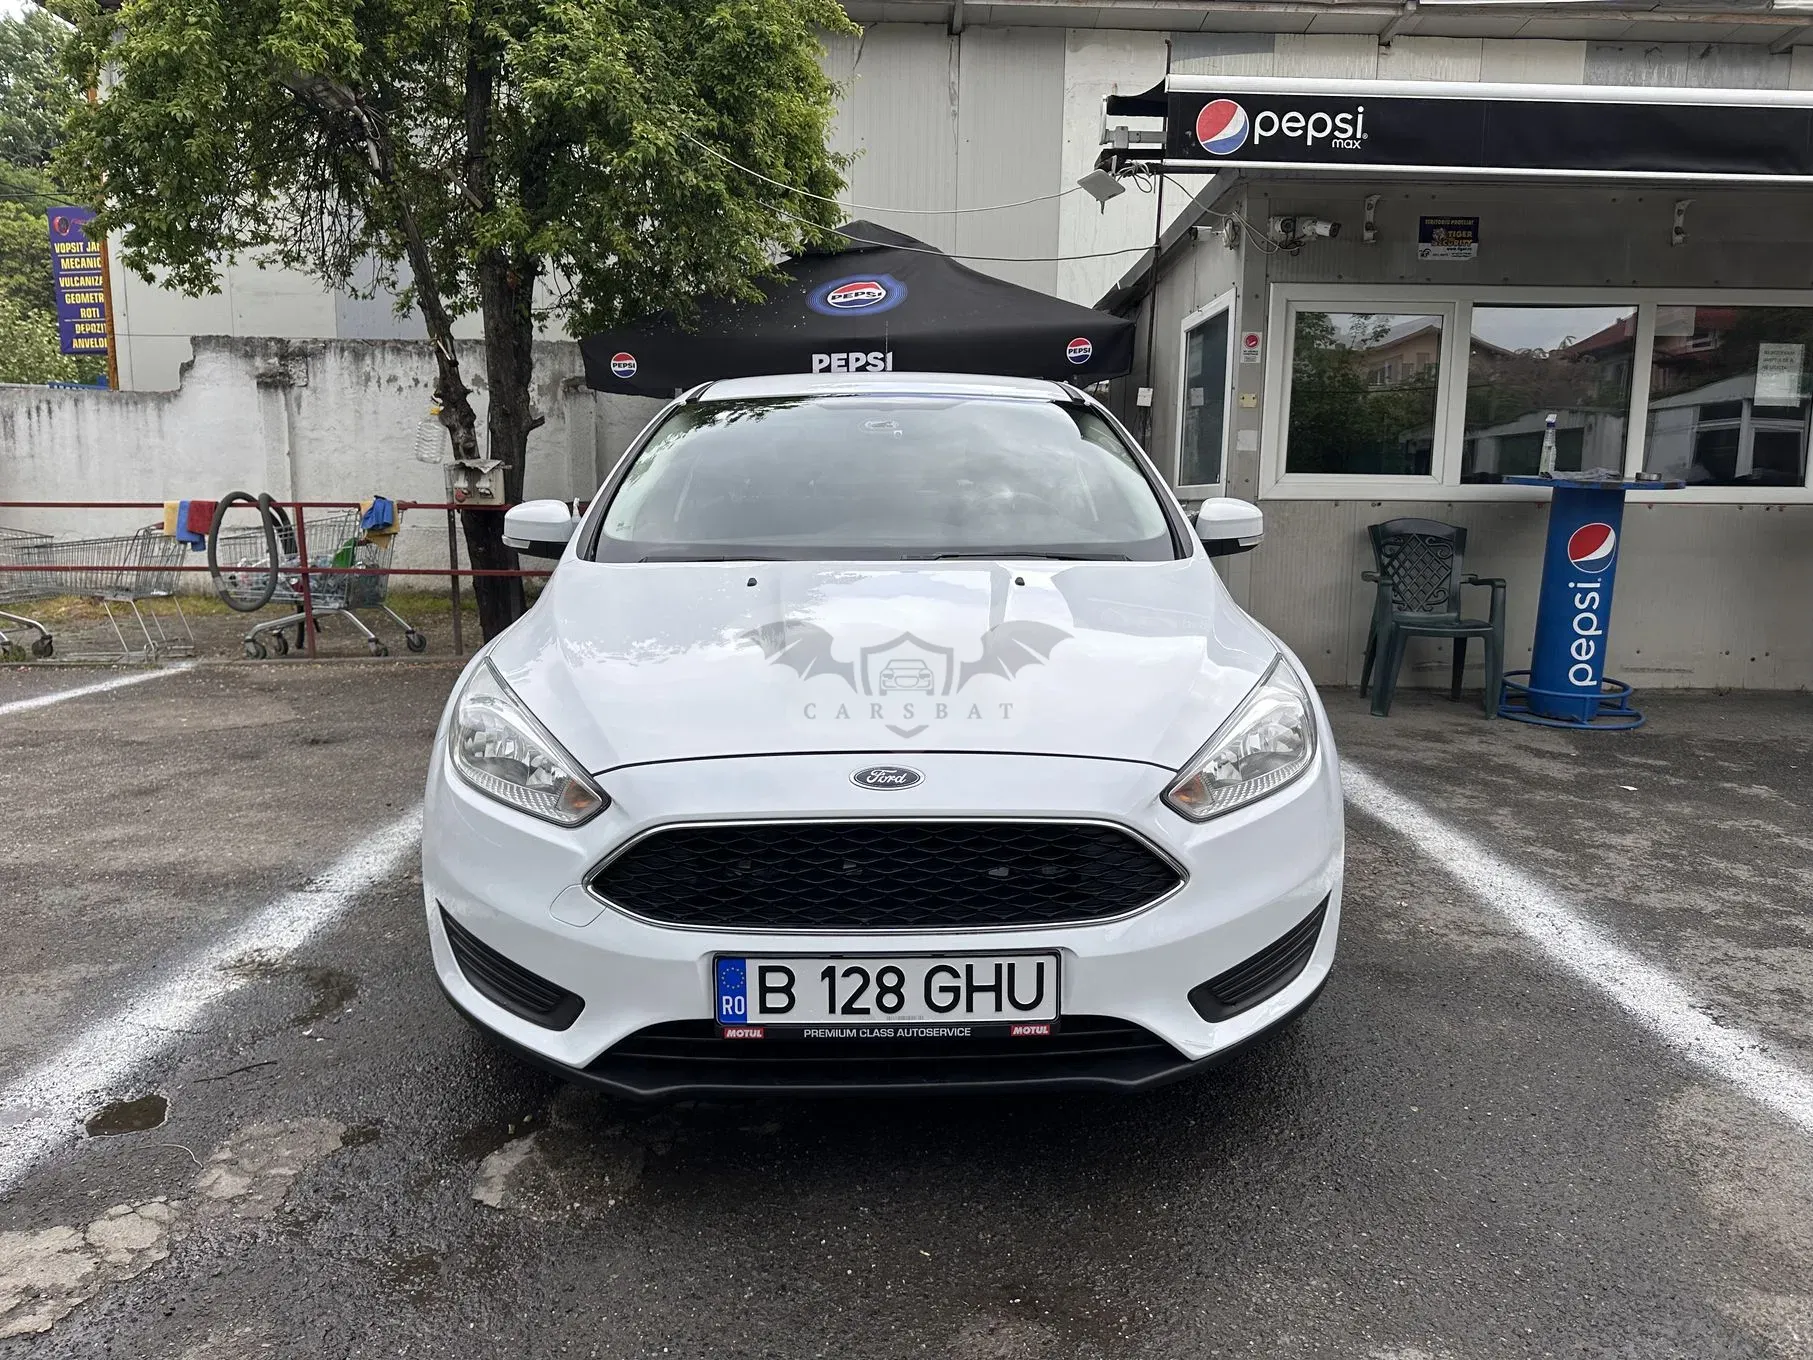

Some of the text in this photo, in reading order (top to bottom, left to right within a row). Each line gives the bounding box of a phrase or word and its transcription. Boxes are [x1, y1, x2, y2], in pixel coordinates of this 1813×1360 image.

[1254, 105, 1364, 146] pepsi
[1331, 138, 1361, 149] max
[1448, 230, 1472, 238] TIGER
[54, 241, 84, 253] VOPSIT
[65, 292, 105, 304] GEOMETR
[831, 291, 883, 300] PEPSI
[80, 307, 100, 318] ROTI
[1068, 347, 1091, 355] PEPSI
[812, 351, 893, 373] PEPSI
[1568, 581, 1603, 687] pepsi
[866, 769, 907, 784] Ford
[722, 961, 1045, 1015] RO B 128 GHU
[726, 1025, 1049, 1038] MOTUL PREMIUM CLASS AUTOSERVICE MOTUL
